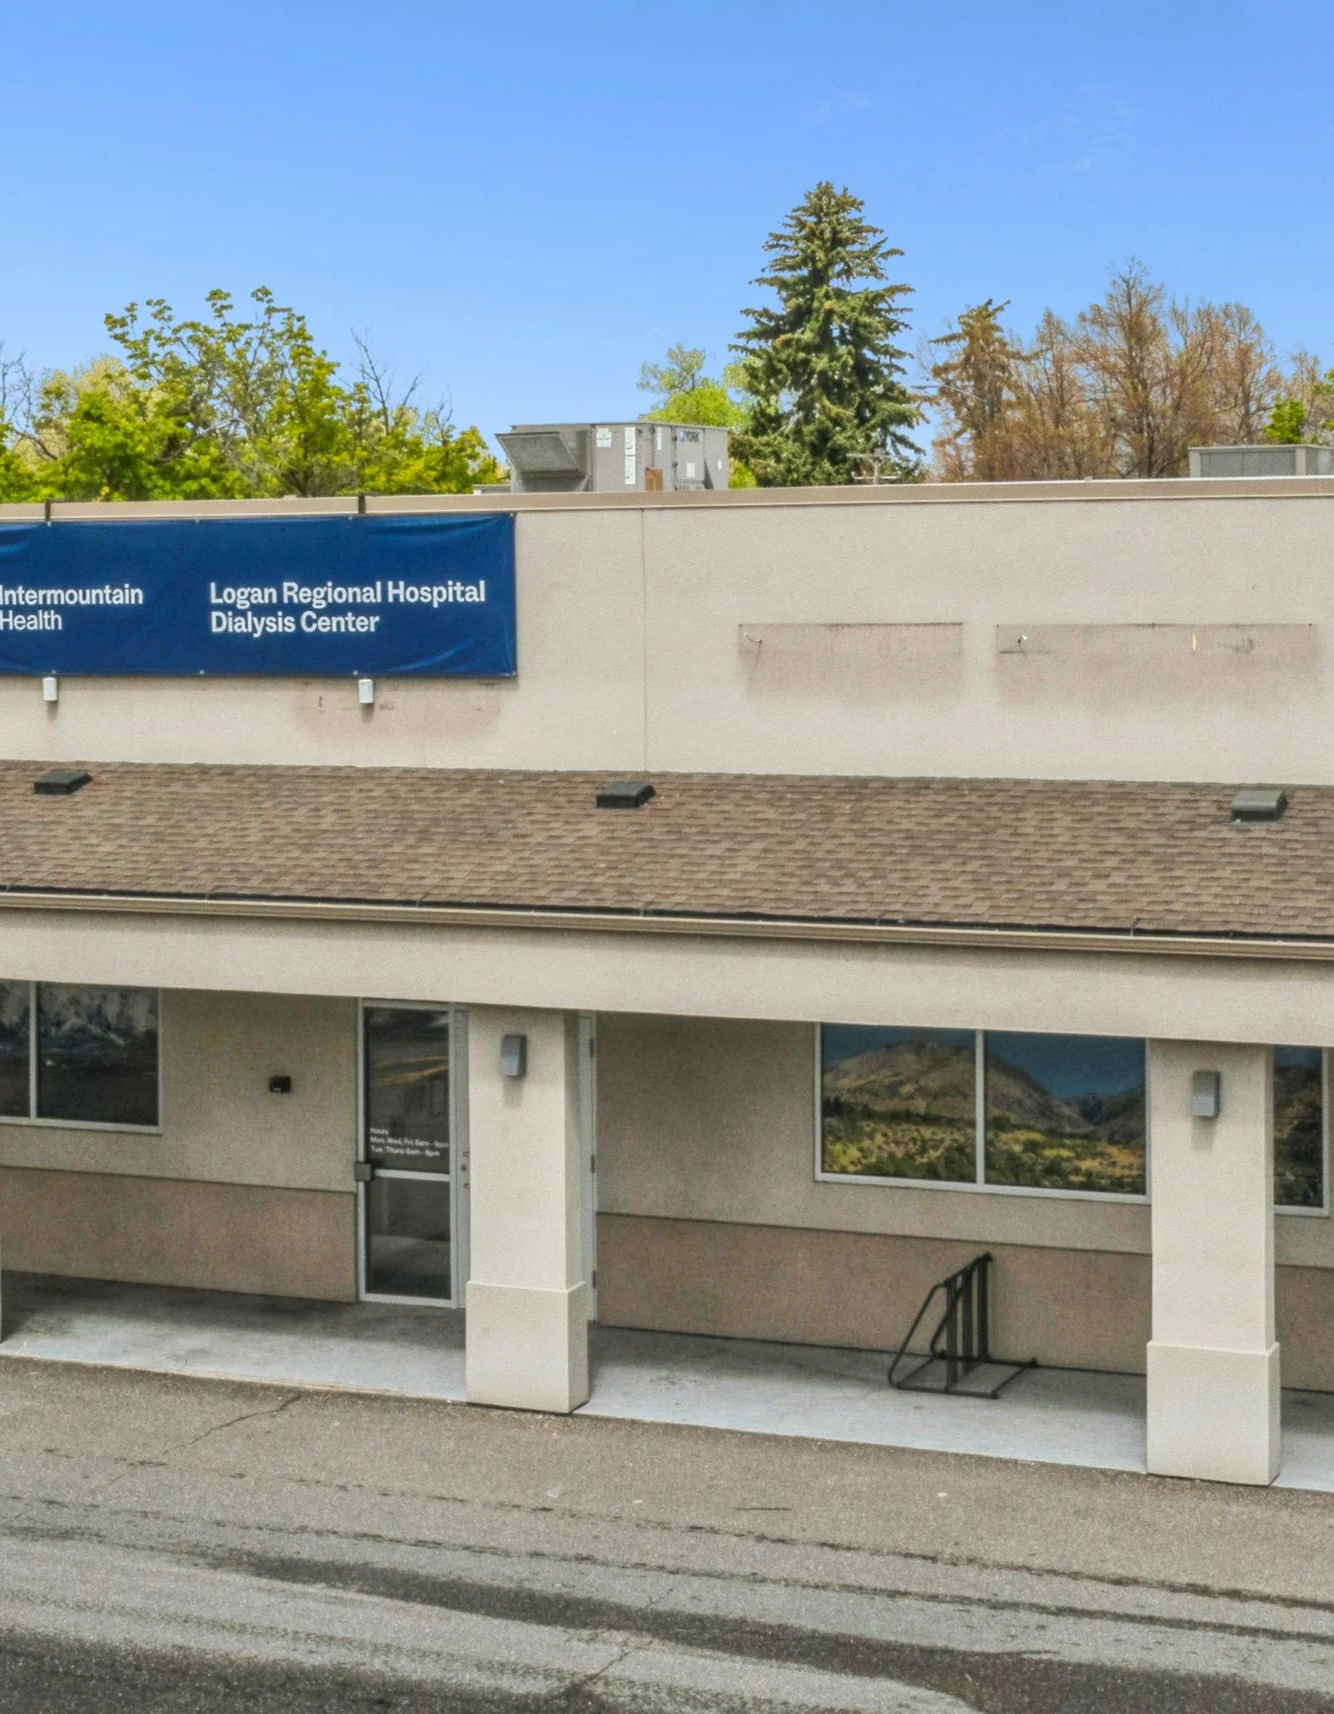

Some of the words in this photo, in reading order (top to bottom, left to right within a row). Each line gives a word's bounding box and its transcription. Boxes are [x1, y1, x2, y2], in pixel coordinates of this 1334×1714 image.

[210, 582, 277, 609] Logan
[282, 581, 382, 609] Regional
[387, 580, 486, 608] Hospital
[210, 611, 296, 638] Dialysis
[300, 610, 380, 632] Center
[370, 1127, 389, 1135] Hours
